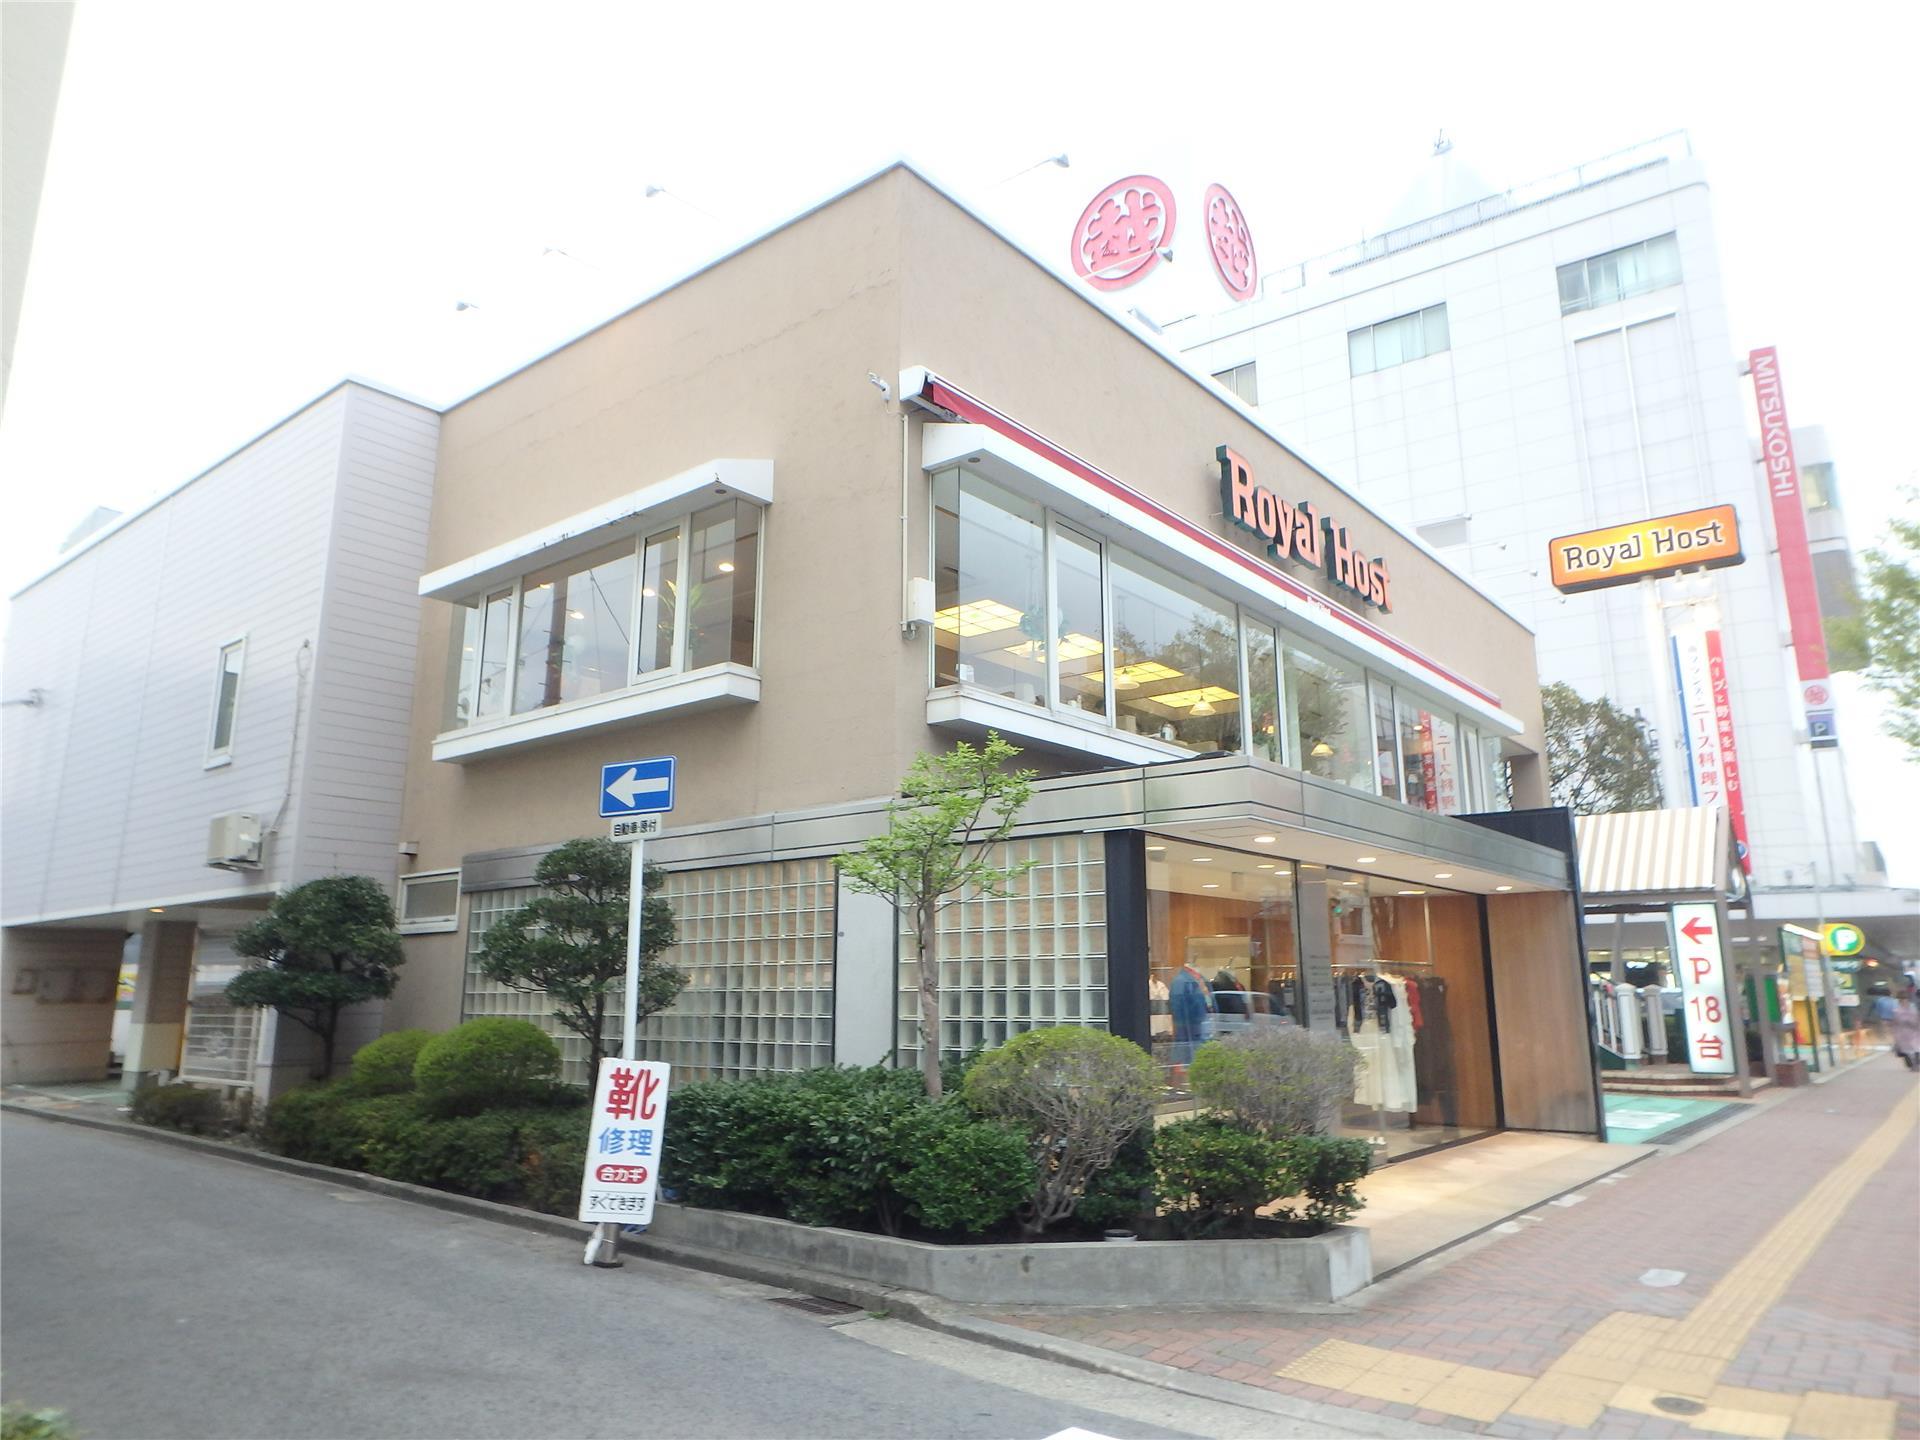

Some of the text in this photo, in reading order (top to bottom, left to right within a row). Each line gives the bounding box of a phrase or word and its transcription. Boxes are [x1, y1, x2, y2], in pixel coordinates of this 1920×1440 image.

[1755, 355, 1795, 497] MITSUKOSHI
[1218, 445, 1393, 613] Royal Host
[1563, 521, 1724, 570] Royal Host
[1689, 957, 1724, 1060] P 18 台
[606, 1067, 660, 1120] 靴
[598, 1126, 654, 1157] 修理
[600, 1167, 643, 1182] 合カギ
[589, 1193, 645, 1211] すぐできます
